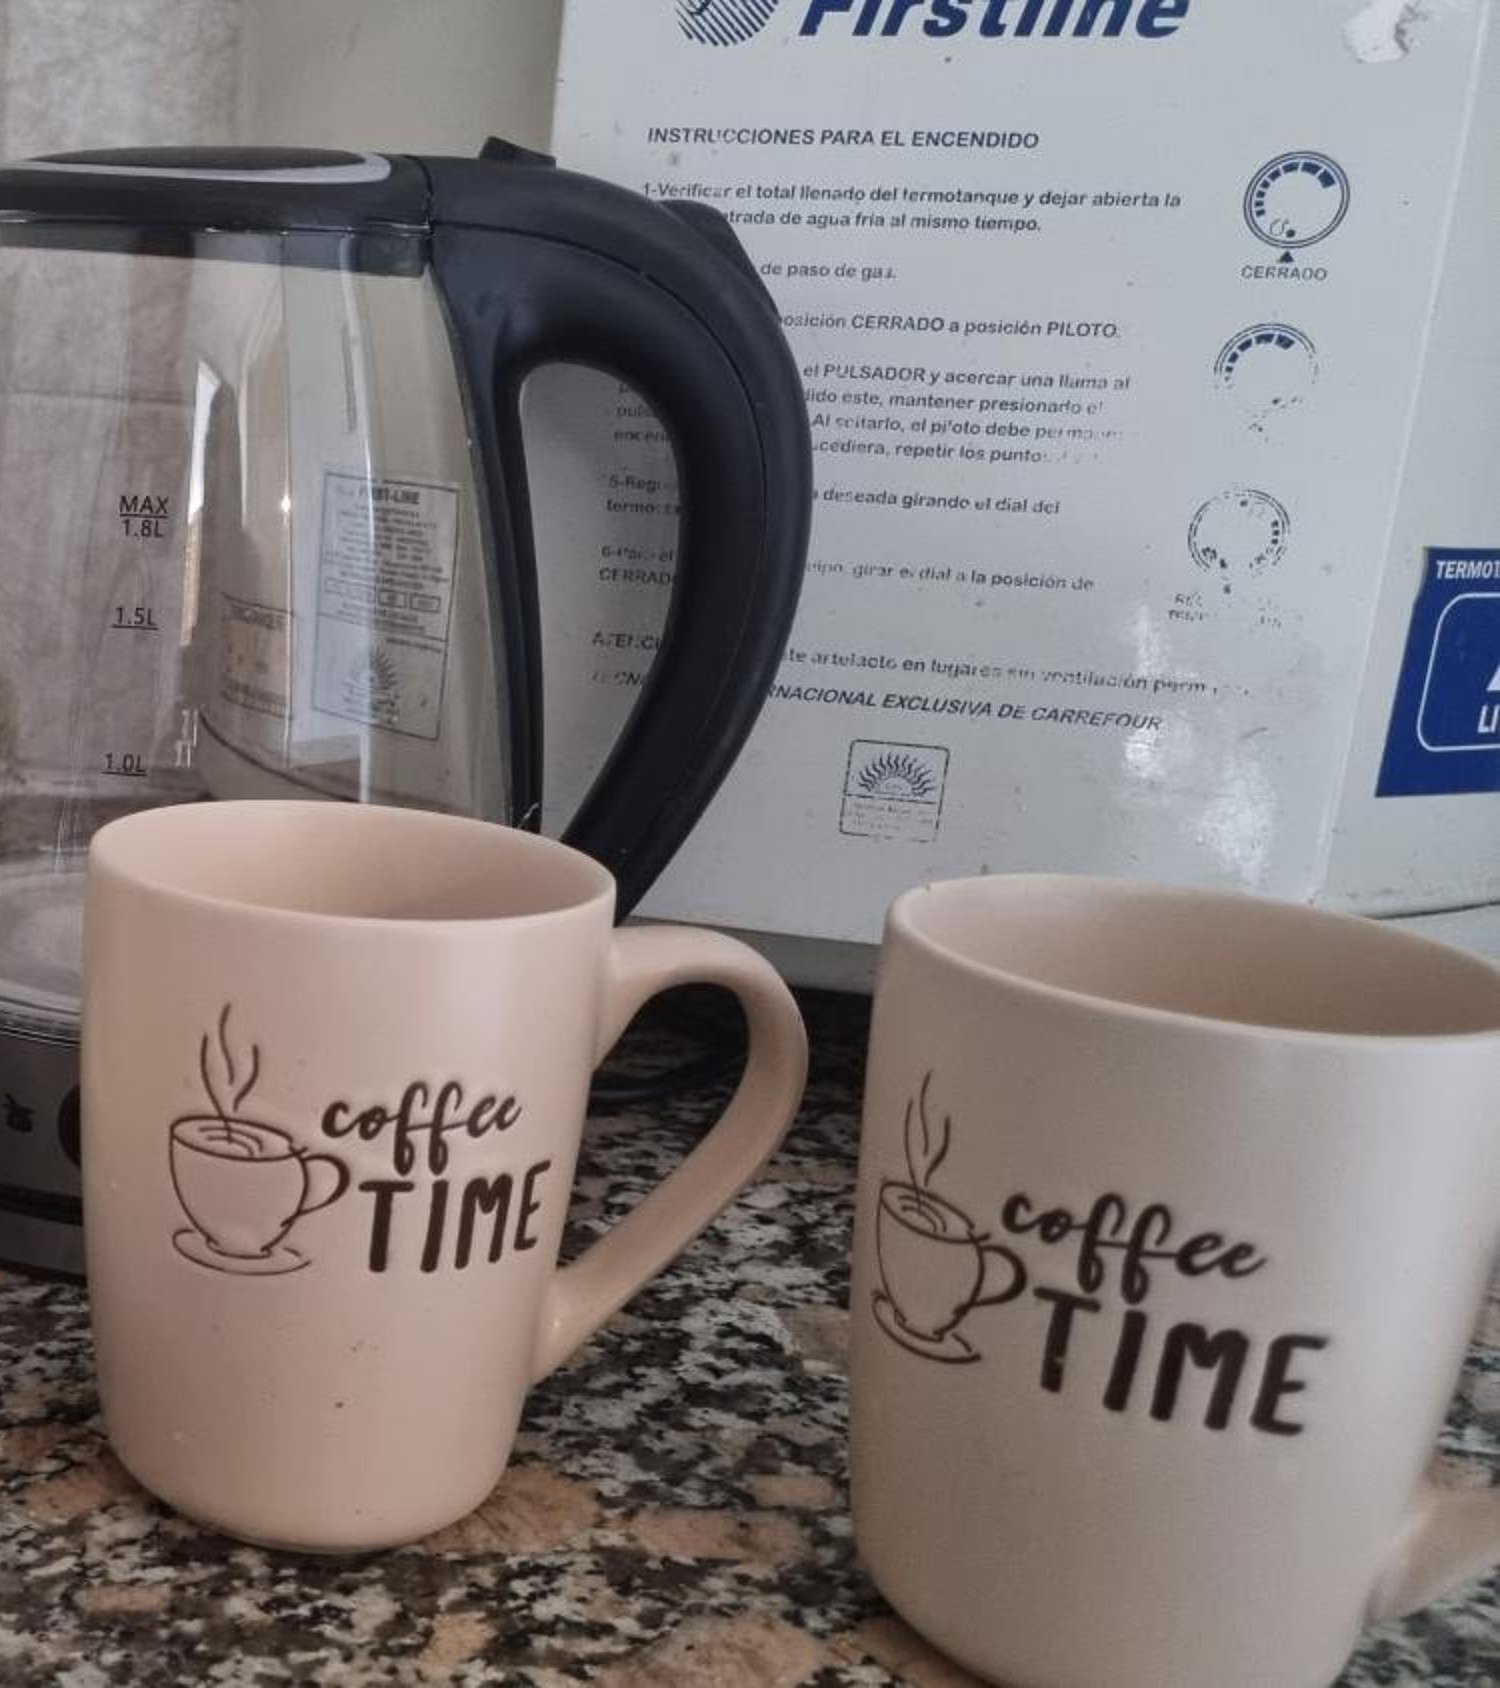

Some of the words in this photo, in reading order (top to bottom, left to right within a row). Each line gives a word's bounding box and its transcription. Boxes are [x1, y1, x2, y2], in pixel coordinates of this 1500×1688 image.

[647, 127, 815, 145] INSTRUCCIONES
[820, 130, 875, 146] PARA
[881, 131, 905, 147] EL
[911, 131, 1040, 149] ENCENDIDO
[736, 185, 751, 200] el
[756, 185, 797, 200] total
[801, 187, 866, 202] llenado
[869, 188, 899, 202] del
[903, 188, 1019, 207] termotanque
[1022, 193, 1035, 208] y
[1039, 190, 1089, 209] dejar
[1092, 191, 1160, 208] abierta
[1164, 193, 1181, 208] la
[780, 211, 802, 225] de
[806, 213, 850, 230] agua
[890, 214, 906, 229] al
[910, 215, 970, 230] mismo
[975, 216, 1042, 233] tiempo.
[760, 260, 783, 276] de
[787, 262, 831, 279] paso
[834, 262, 857, 278] de
[1240, 264, 1328, 282] CERRADO
[851, 314, 945, 332] CERRADO
[948, 320, 960, 333] a
[964, 319, 1042, 336] posición
[803, 363, 820, 378] el
[823, 363, 926, 383] PULSADOR
[929, 371, 941, 386] y
[945, 370, 1017, 386] acercar
[1020, 374, 1054, 389] una
[1058, 373, 1108, 390] llama
[1112, 376, 1131, 391] al
[841, 391, 884, 407] este,
[888, 392, 975, 410] mantener
[811, 412, 831, 428] Al
[910, 418, 927, 432] el
[985, 421, 1031, 438] debe
[894, 441, 957, 460] repetir
[960, 444, 985, 461] los
[118, 495, 169, 515] MAX
[822, 487, 898, 506] deseada
[901, 492, 971, 510] girando
[995, 497, 1028, 513] dial
[121, 519, 165, 538] 1.8L
[852, 563, 895, 580] girar
[899, 566, 914, 580] e
[970, 569, 988, 585] la
[991, 573, 1068, 590] posición
[1071, 576, 1095, 591] de
[115, 607, 156, 626] 1.5L
[902, 658, 926, 673] en
[881, 692, 992, 718] EXCLUSIVA
[997, 702, 1027, 720] DE
[1031, 706, 1164, 731] CARREFOUR
[104, 753, 146, 773] 1.0L
[320, 1080, 523, 1176] coffee
[357, 1159, 552, 1274] TIME
[1001, 1191, 1269, 1306] coffee
[1032, 1286, 1331, 1436] TIME
